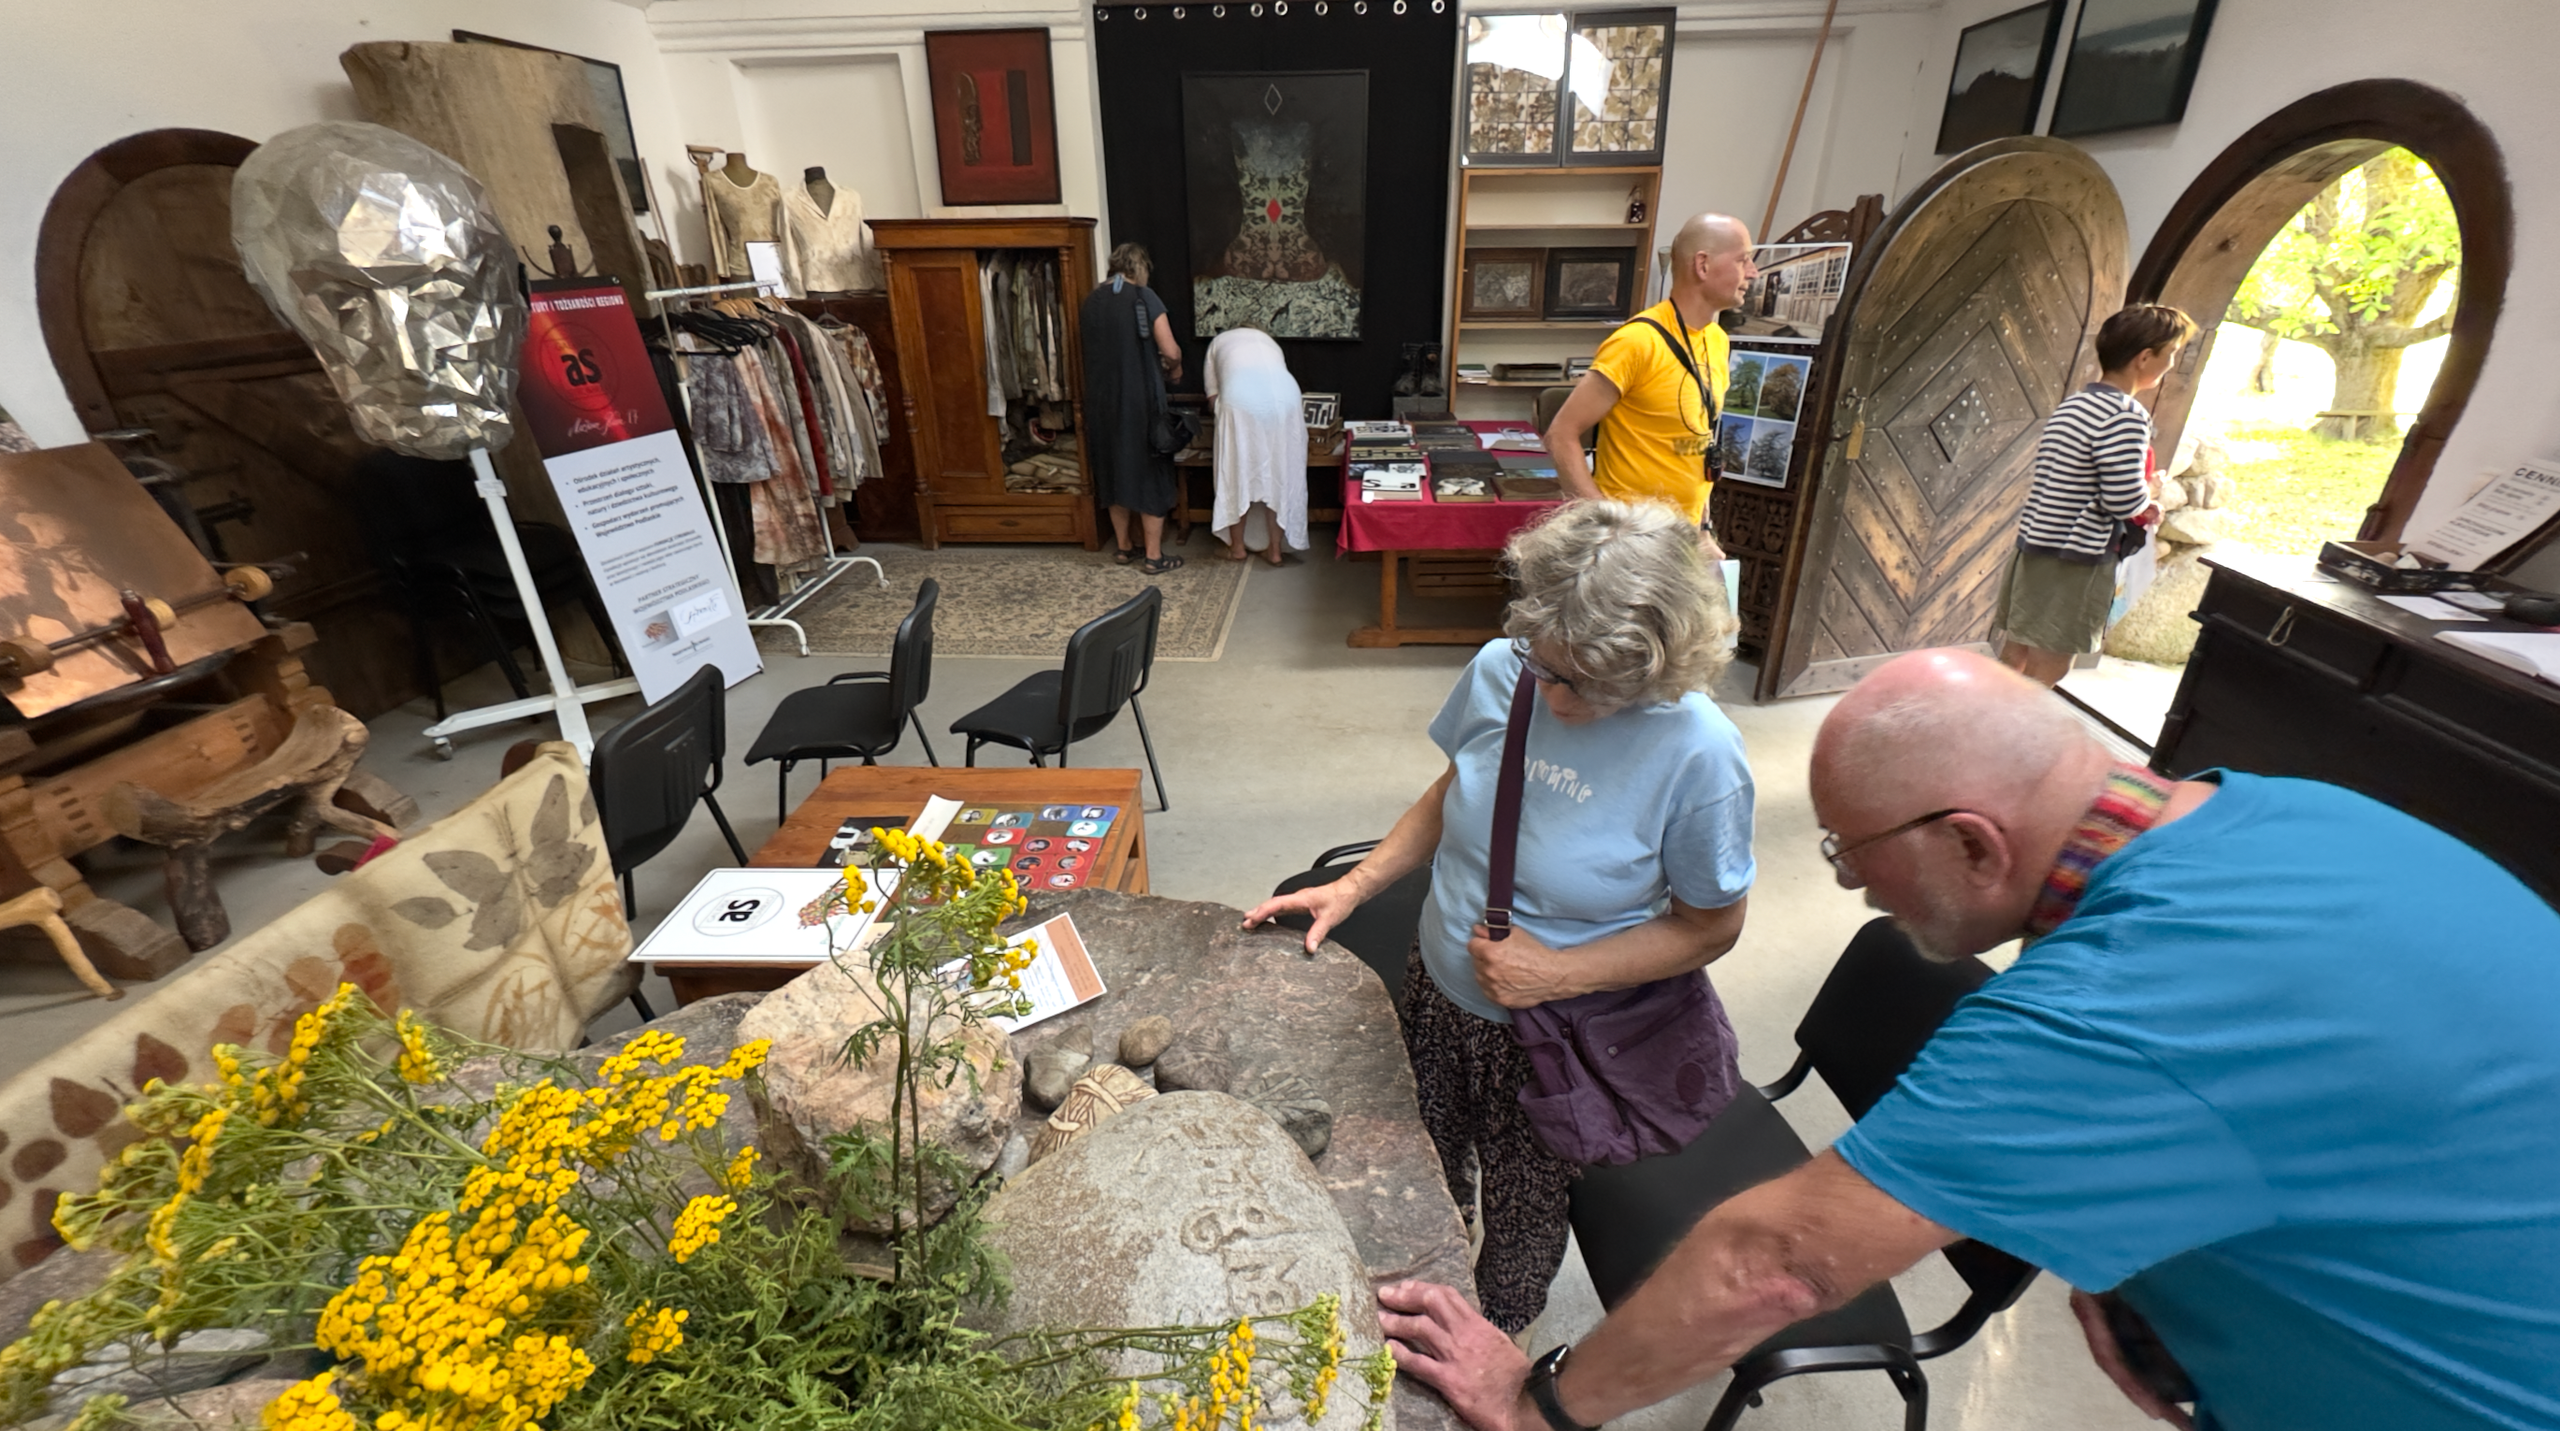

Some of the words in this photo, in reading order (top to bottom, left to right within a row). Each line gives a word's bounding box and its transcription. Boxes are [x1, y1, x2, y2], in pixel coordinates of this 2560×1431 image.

[595, 294, 624, 307] REGIONU
[561, 348, 602, 387] as
[718, 899, 760, 922] as
